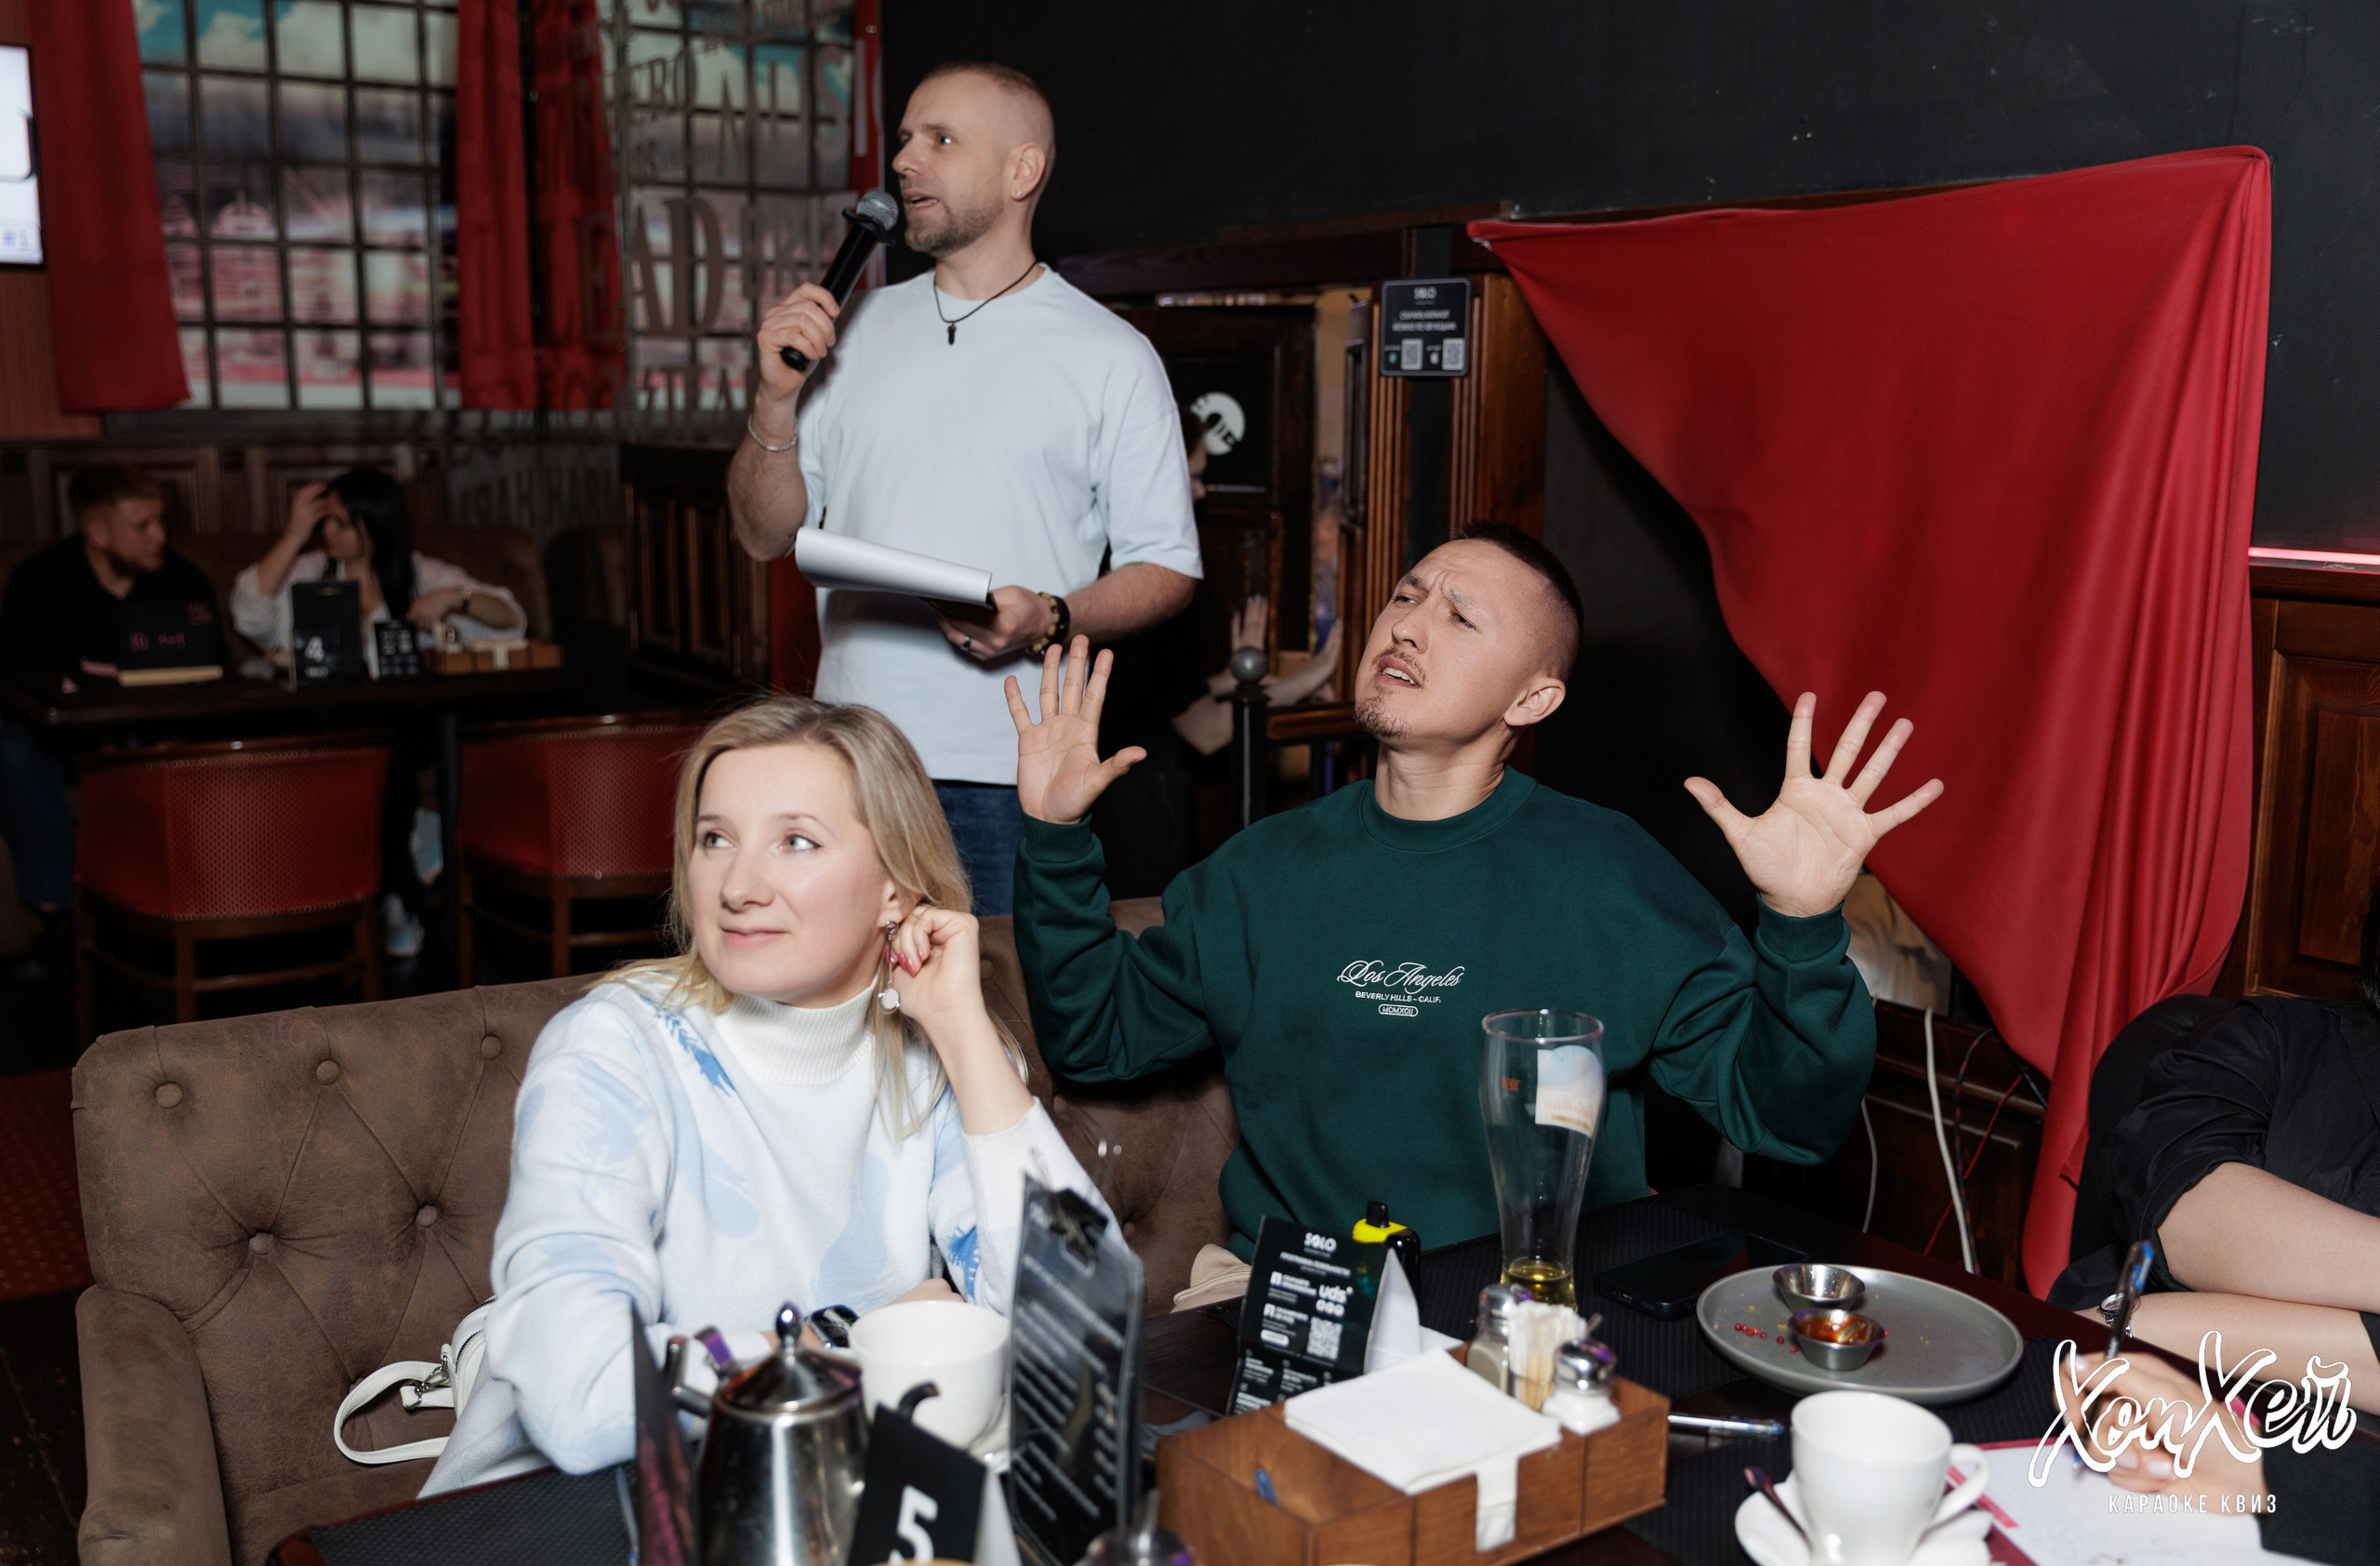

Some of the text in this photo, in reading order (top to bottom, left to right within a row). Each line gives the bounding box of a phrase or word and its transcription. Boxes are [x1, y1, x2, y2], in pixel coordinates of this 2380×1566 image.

[1337, 960, 1465, 994] Los Angeles
[1355, 990, 1390, 1001] BEVERLY
[1390, 993, 1412, 1002] HILLS
[1418, 995, 1442, 1003] CALIF.
[1382, 1005, 1414, 1015] MCMXCII
[1304, 1232, 1337, 1253] SOLO
[888, 1483, 938, 1564] 5
